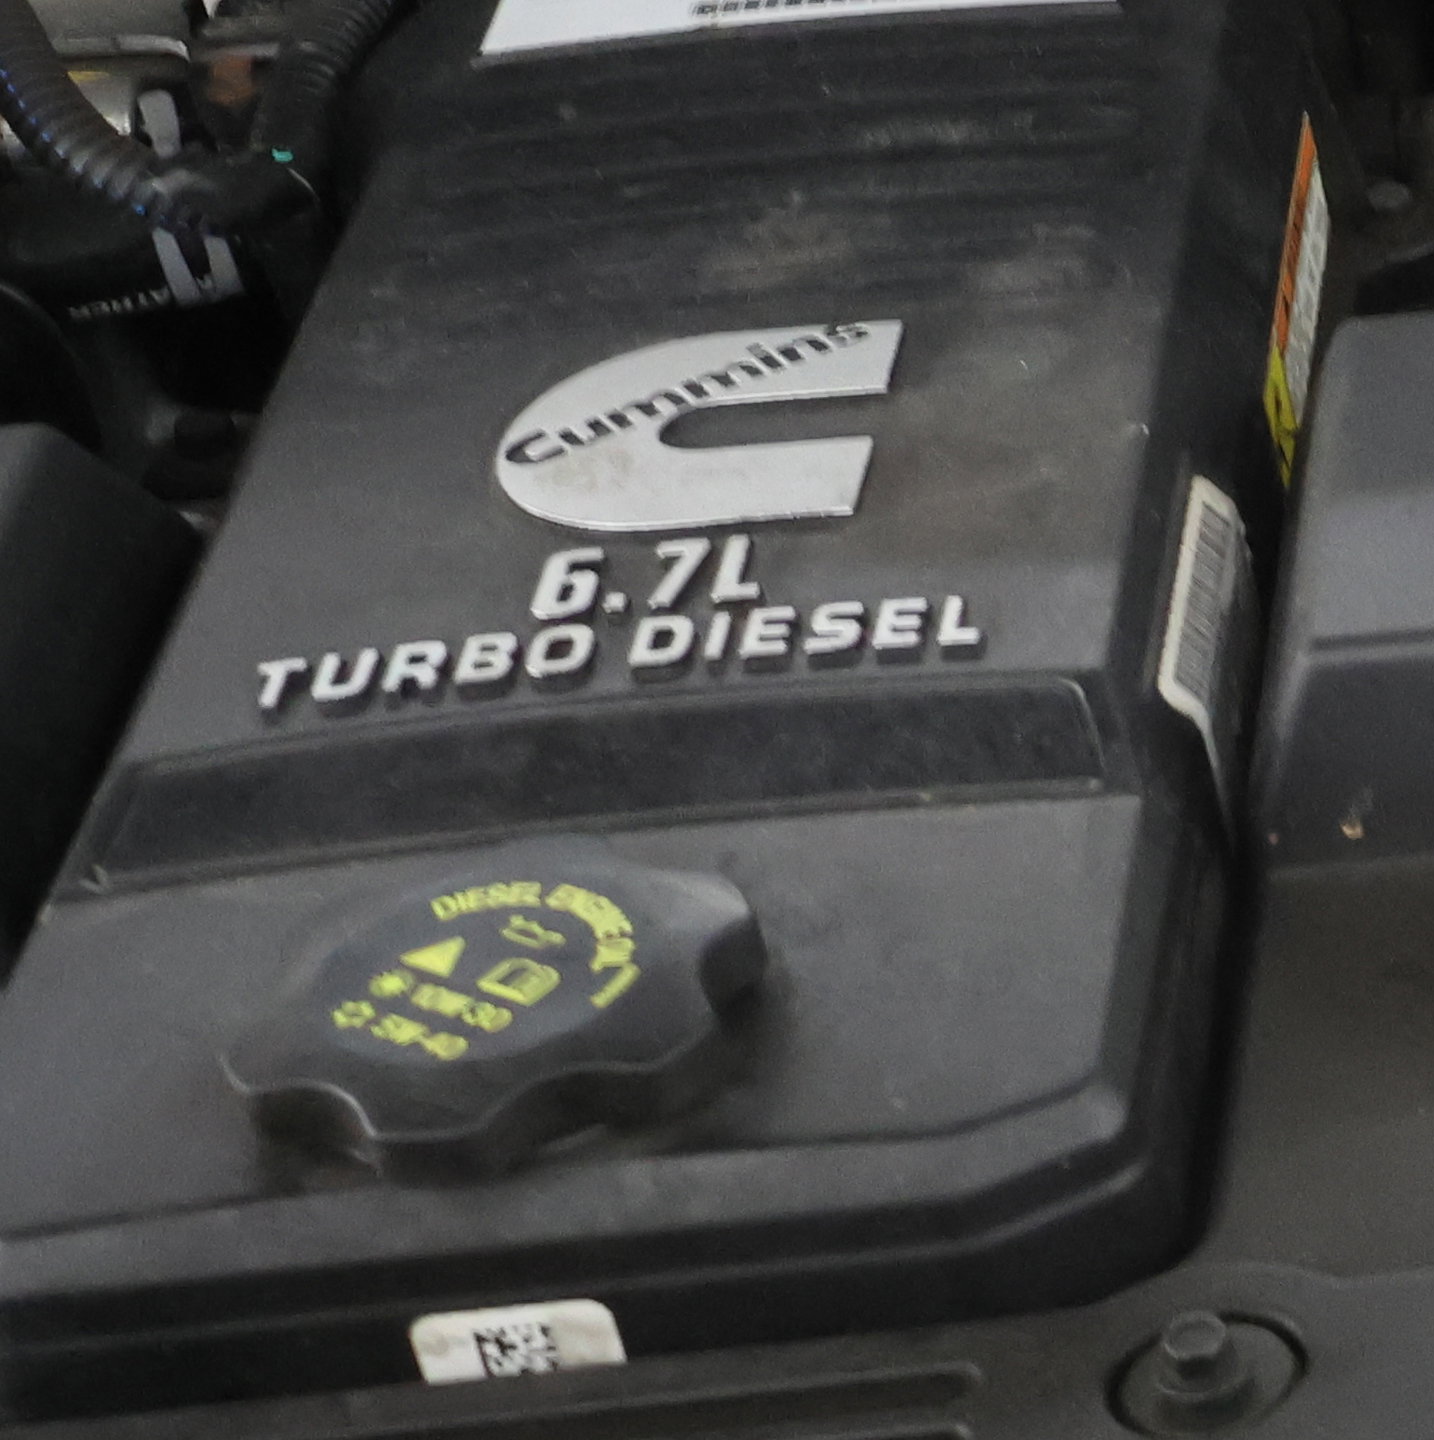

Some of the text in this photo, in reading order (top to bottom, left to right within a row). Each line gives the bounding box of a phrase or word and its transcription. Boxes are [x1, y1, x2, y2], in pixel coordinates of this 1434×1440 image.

[505, 322, 870, 462] Cummins
[531, 534, 759, 620] 6.7L
[257, 594, 981, 709] TURBO DIESEL
